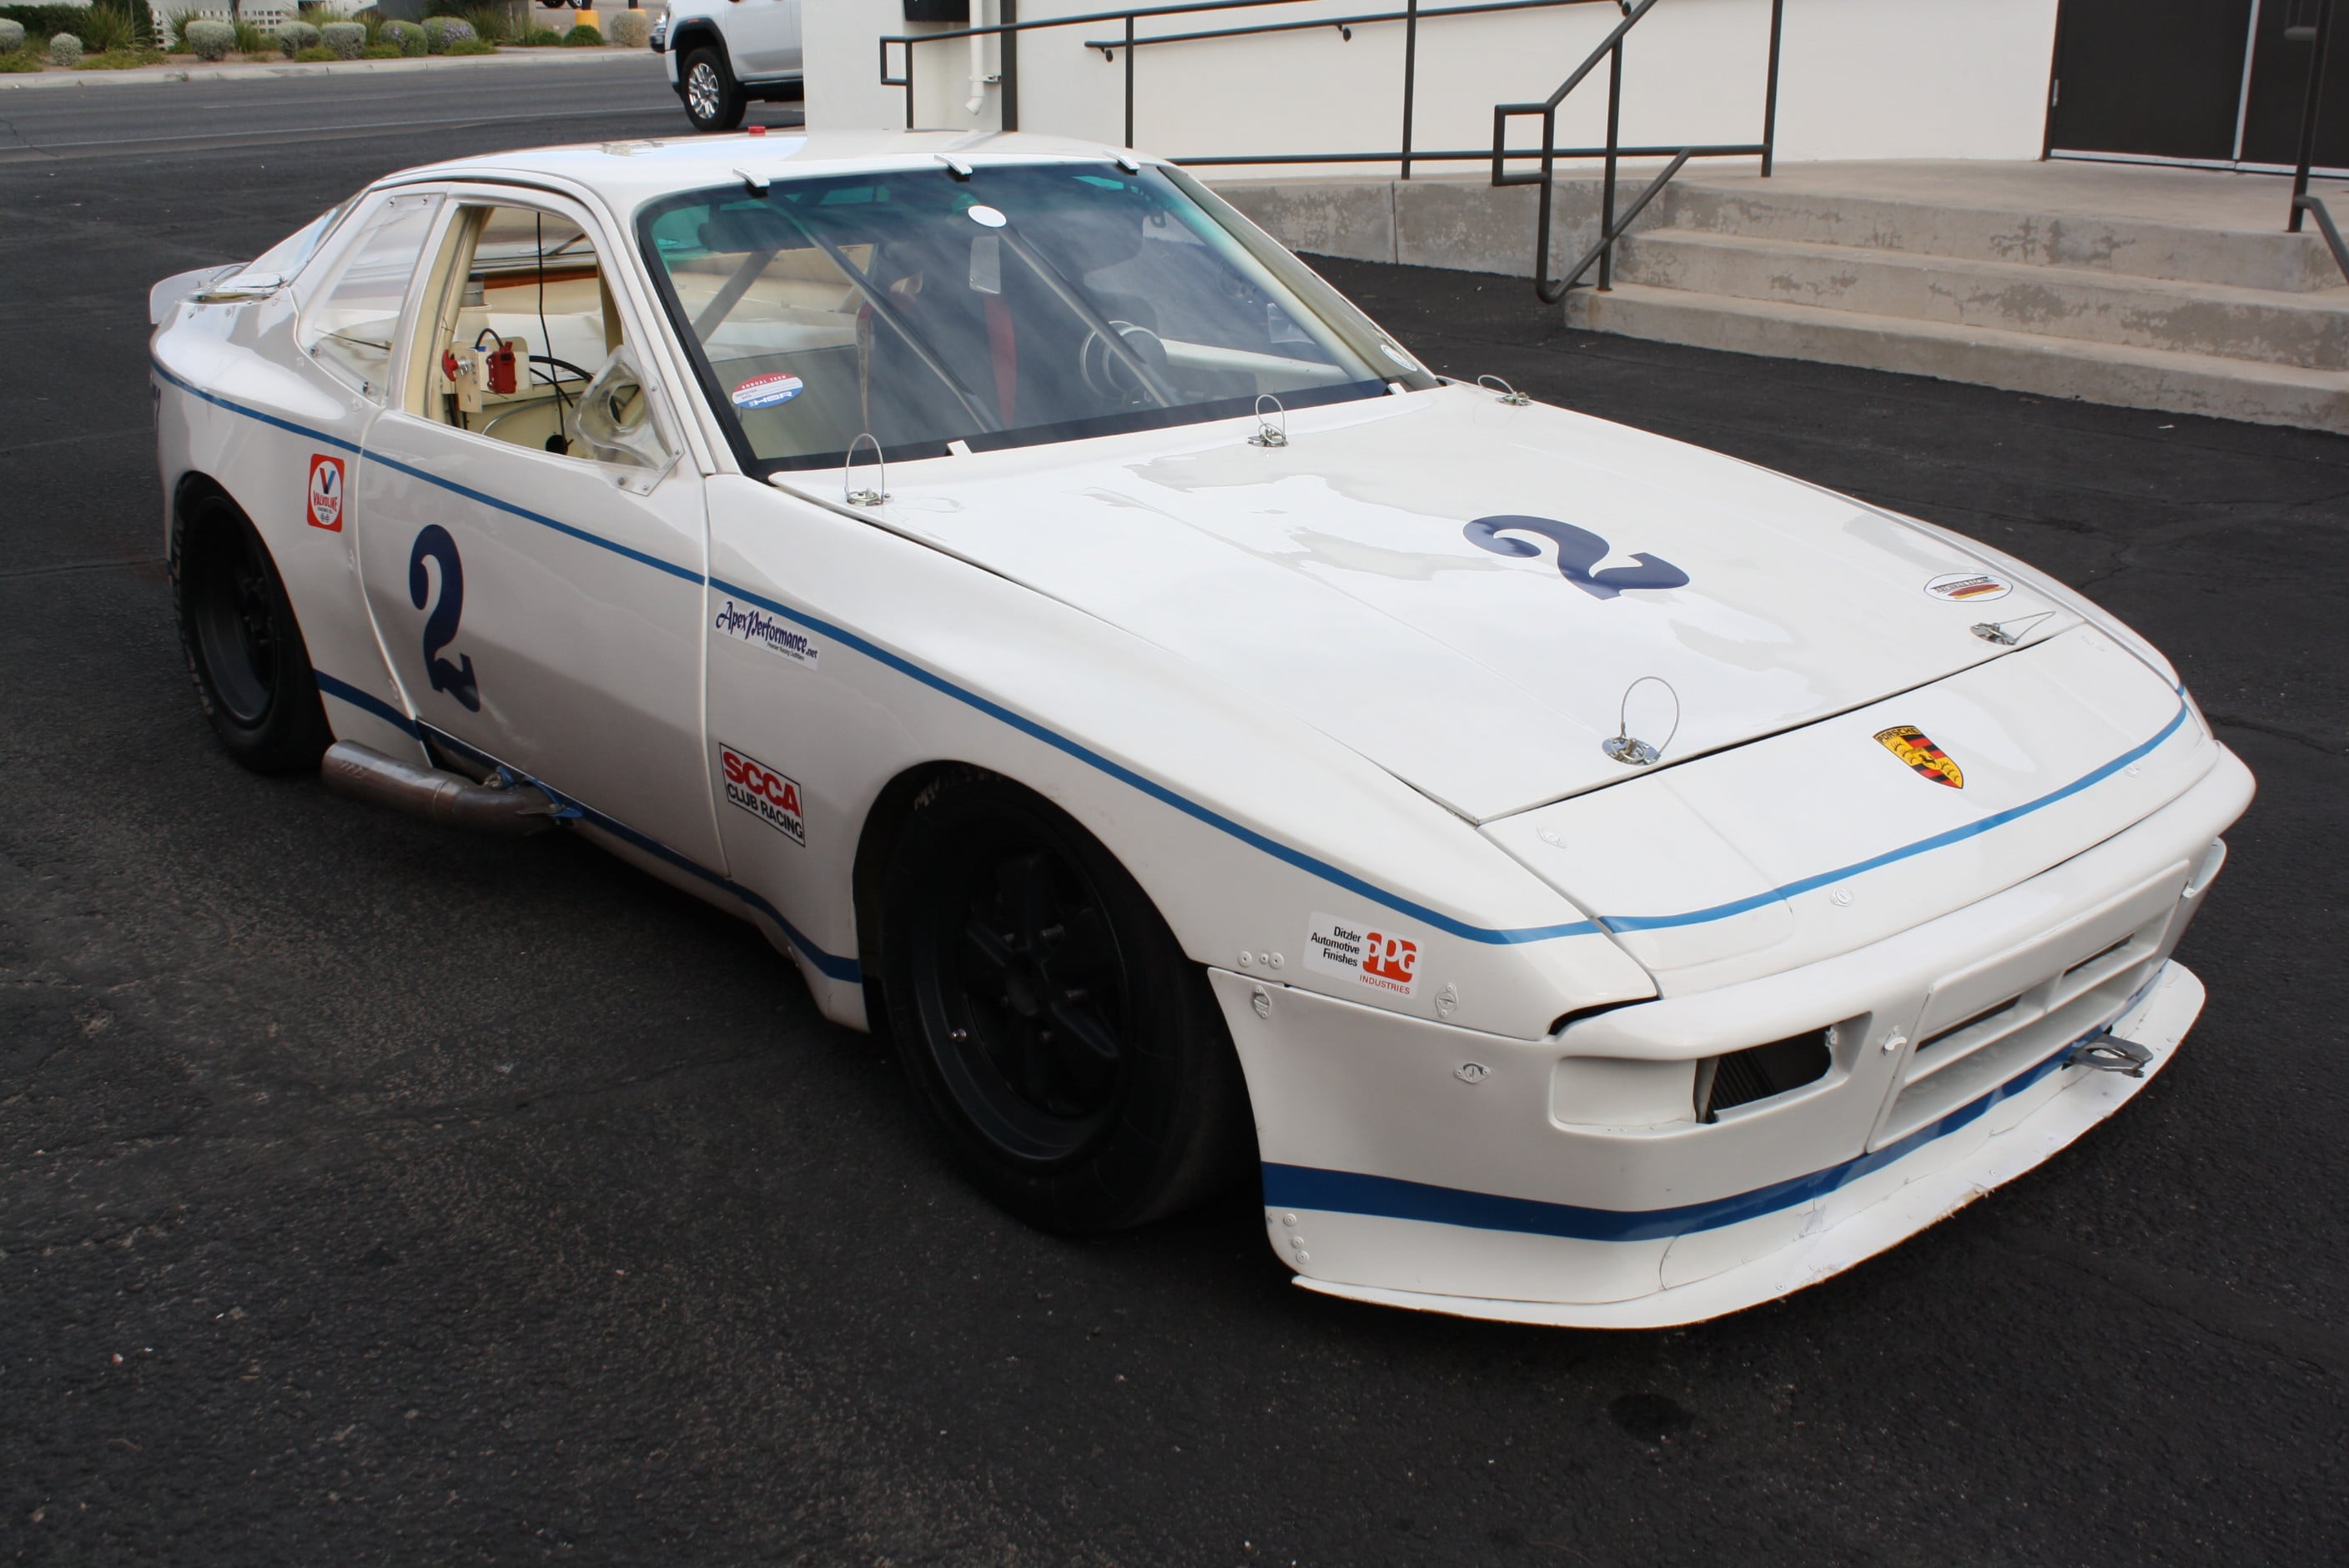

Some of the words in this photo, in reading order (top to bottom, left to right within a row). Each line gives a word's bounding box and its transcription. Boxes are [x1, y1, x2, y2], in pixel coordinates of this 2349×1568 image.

[314, 490, 338, 511] VALVOLINE
[1462, 515, 1691, 601] 2
[409, 524, 481, 713] 2
[1877, 727, 1920, 743] PORSCHE
[722, 751, 802, 818] SCCA
[727, 783, 758, 811] CLUB
[760, 799, 803, 839] RACING
[1310, 932, 1361, 954] Automotive
[1334, 926, 1362, 943] Ditzler
[1323, 947, 1358, 967] Finishes
[1360, 974, 1411, 994] INDUSTRIES
